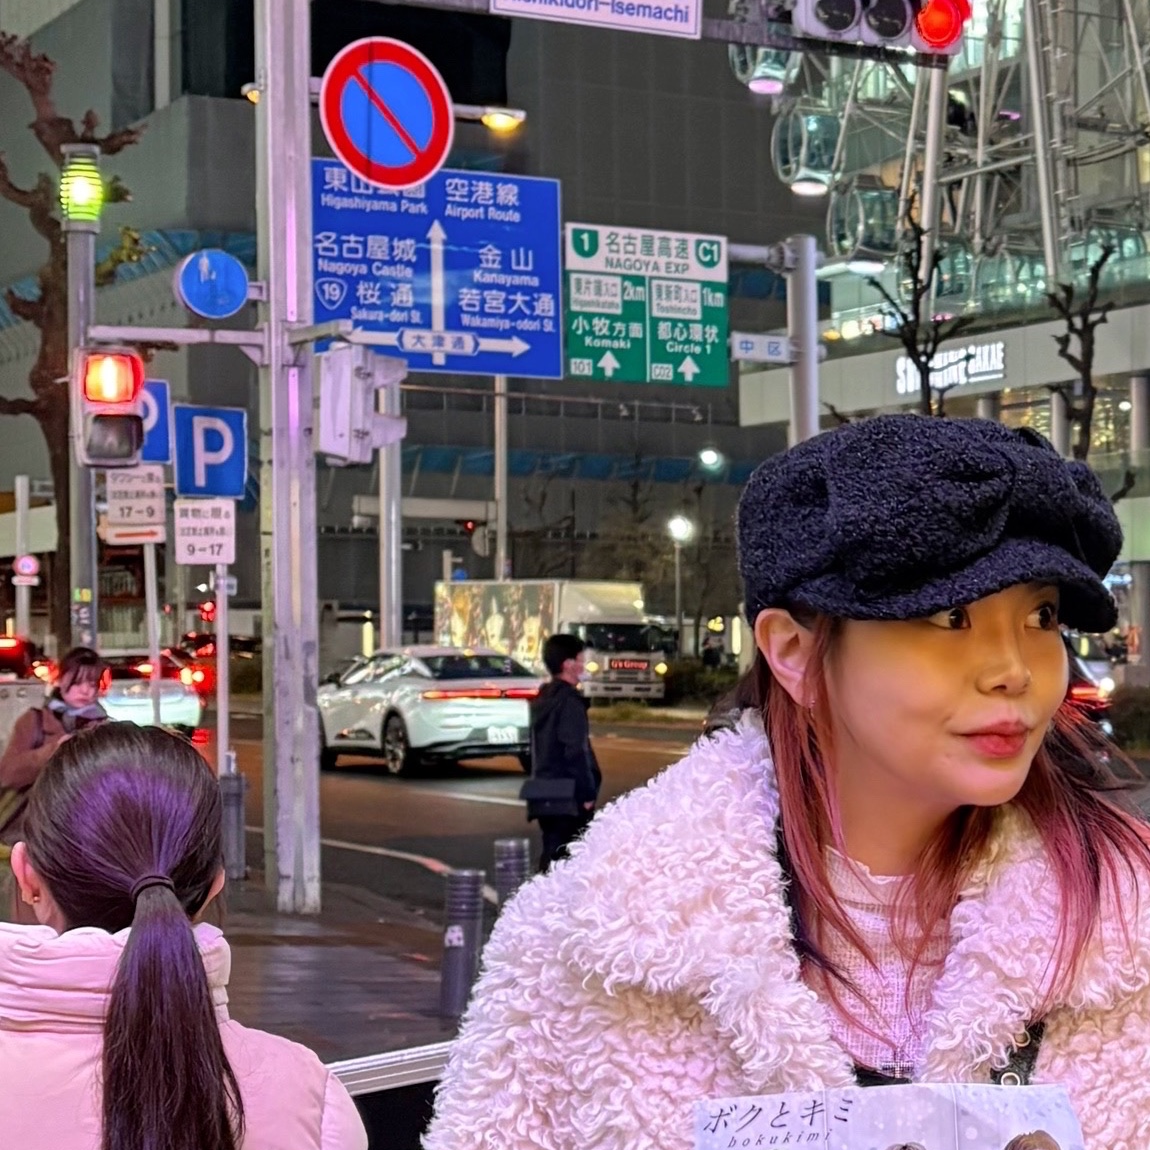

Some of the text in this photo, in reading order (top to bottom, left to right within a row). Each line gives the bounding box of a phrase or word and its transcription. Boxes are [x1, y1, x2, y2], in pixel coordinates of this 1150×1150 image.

[511, 0, 689, 23] dori-Isemachi
[323, 167, 426, 198] 東山園
[445, 178, 520, 206] 空港線
[321, 194, 428, 215] Higashiyama Park
[445, 205, 521, 222] Airport Route
[315, 232, 417, 262] 名古屋城
[580, 232, 590, 252] 1
[605, 232, 690, 259] 名古屋高速
[698, 242, 719, 262] C1
[318, 258, 413, 278] Nagoya Castle
[478, 245, 533, 271] 金山
[605, 257, 690, 274] NAGOYA EXP
[473, 270, 539, 287] Kanayama
[322, 283, 341, 301] 19
[356, 281, 414, 308] 桜通
[623, 280, 645, 301] 2km
[702, 287, 725, 308] 1km
[458, 288, 555, 317] 若宮大通
[350, 306, 423, 324] Sakura-dori St.
[460, 314, 556, 332] Wakamiya-odori St.
[572, 316, 643, 338] 小牧方面
[657, 321, 719, 343] 都心環状
[411, 334, 465, 350] 大津通
[585, 336, 631, 349] Komaki
[666, 341, 701, 354] Circle
[739, 340, 781, 356] 中区
[573, 361, 591, 373] 101
[968, 342, 1004, 375] SAKAE
[193, 416, 234, 487] P
[703, 1099, 853, 1134] ボクとキミ
[727, 1128, 833, 1149] bokukimi
